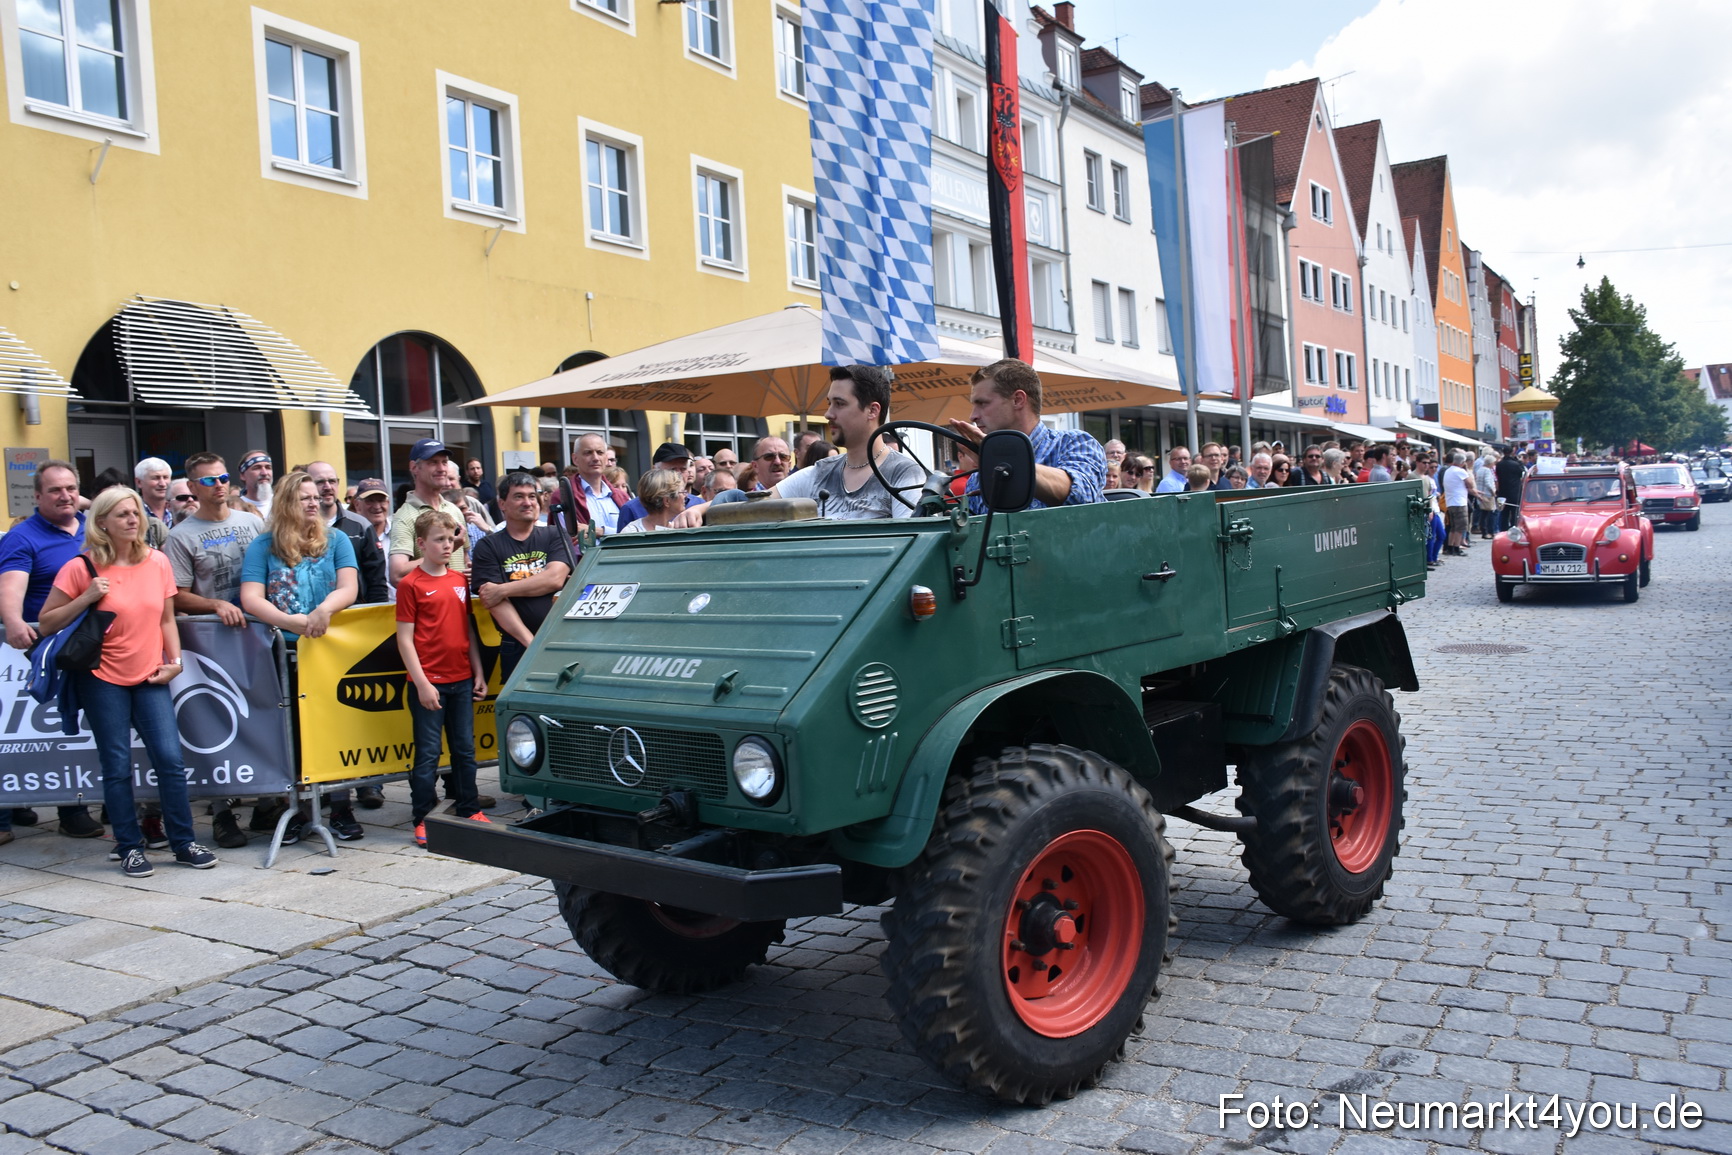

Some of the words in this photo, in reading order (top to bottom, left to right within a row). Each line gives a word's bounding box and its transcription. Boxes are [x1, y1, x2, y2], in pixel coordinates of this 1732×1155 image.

[231, 525, 250, 536] SAM
[1314, 527, 1358, 552] UNIMOG
[588, 585, 613, 600] NM
[611, 655, 702, 678] UNIMOG
[0, 741, 54, 754] BRUNN
